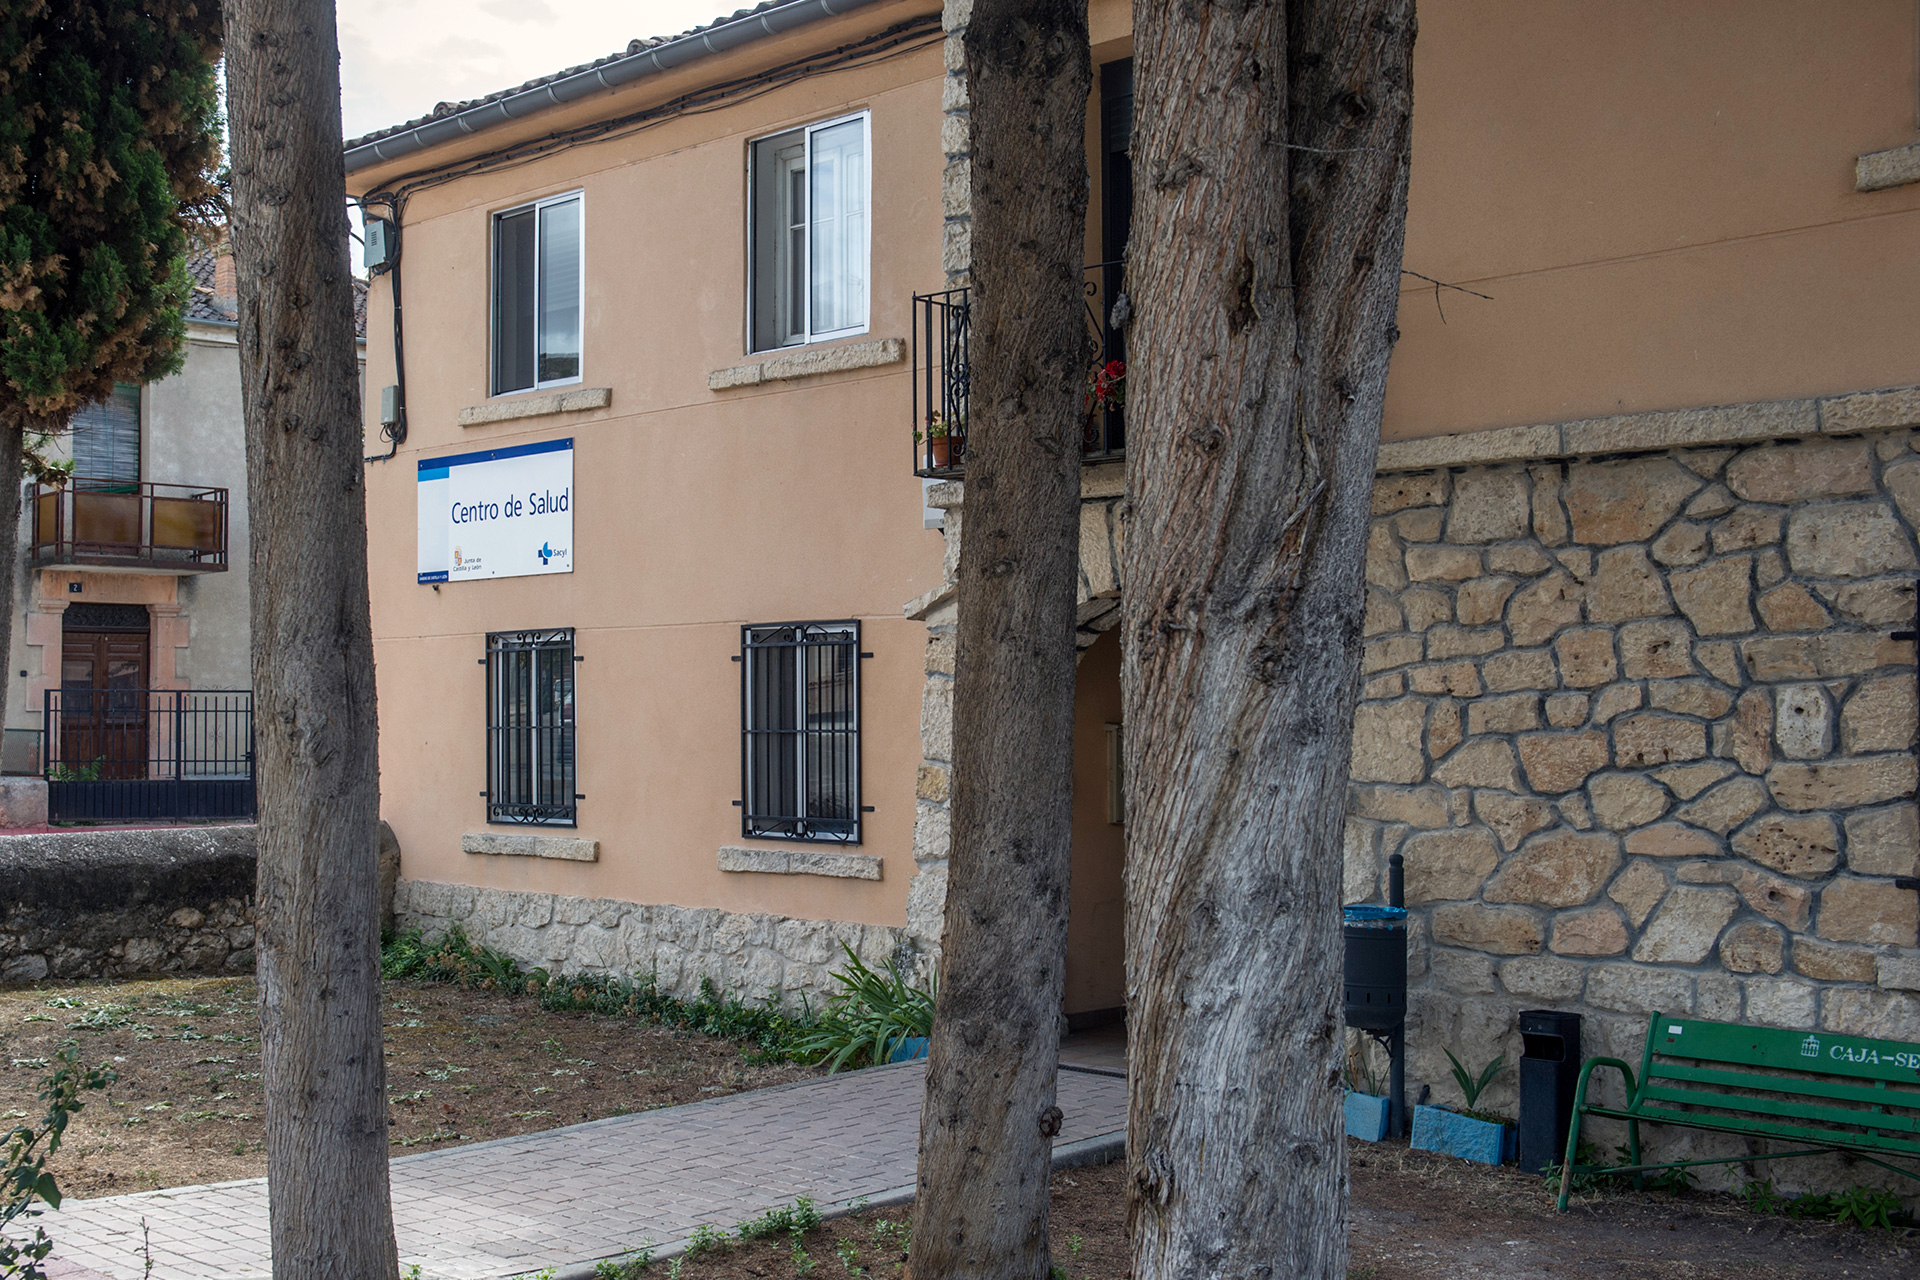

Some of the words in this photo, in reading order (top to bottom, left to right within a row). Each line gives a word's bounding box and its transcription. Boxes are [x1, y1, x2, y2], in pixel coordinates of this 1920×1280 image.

[451, 500, 499, 524] Centro
[504, 494, 522, 518] de
[529, 487, 569, 515] Salud
[553, 548, 567, 558] Sacyl
